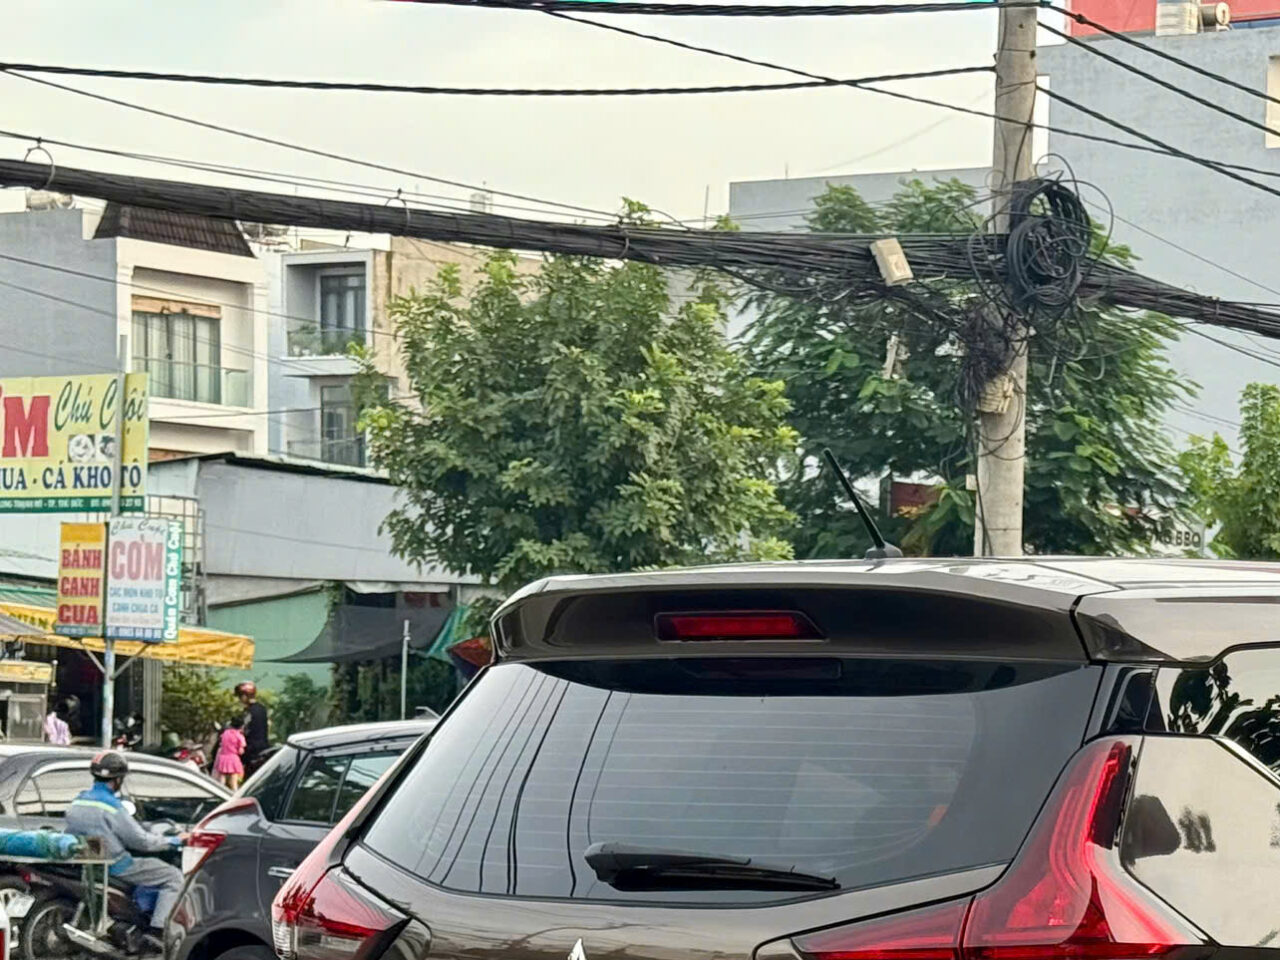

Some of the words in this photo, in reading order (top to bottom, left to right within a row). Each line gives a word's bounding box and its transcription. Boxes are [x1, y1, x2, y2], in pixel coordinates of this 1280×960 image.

[54, 380, 93, 432] Chú
[0, 385, 51, 458] M
[0, 467, 28, 490] UA
[42, 460, 67, 489] CÁ
[72, 466, 112, 489] KHO
[61, 543, 102, 570] BÁNH
[111, 533, 164, 581] CƠM
[60, 576, 100, 598] CANH
[58, 603, 99, 625] CUA
